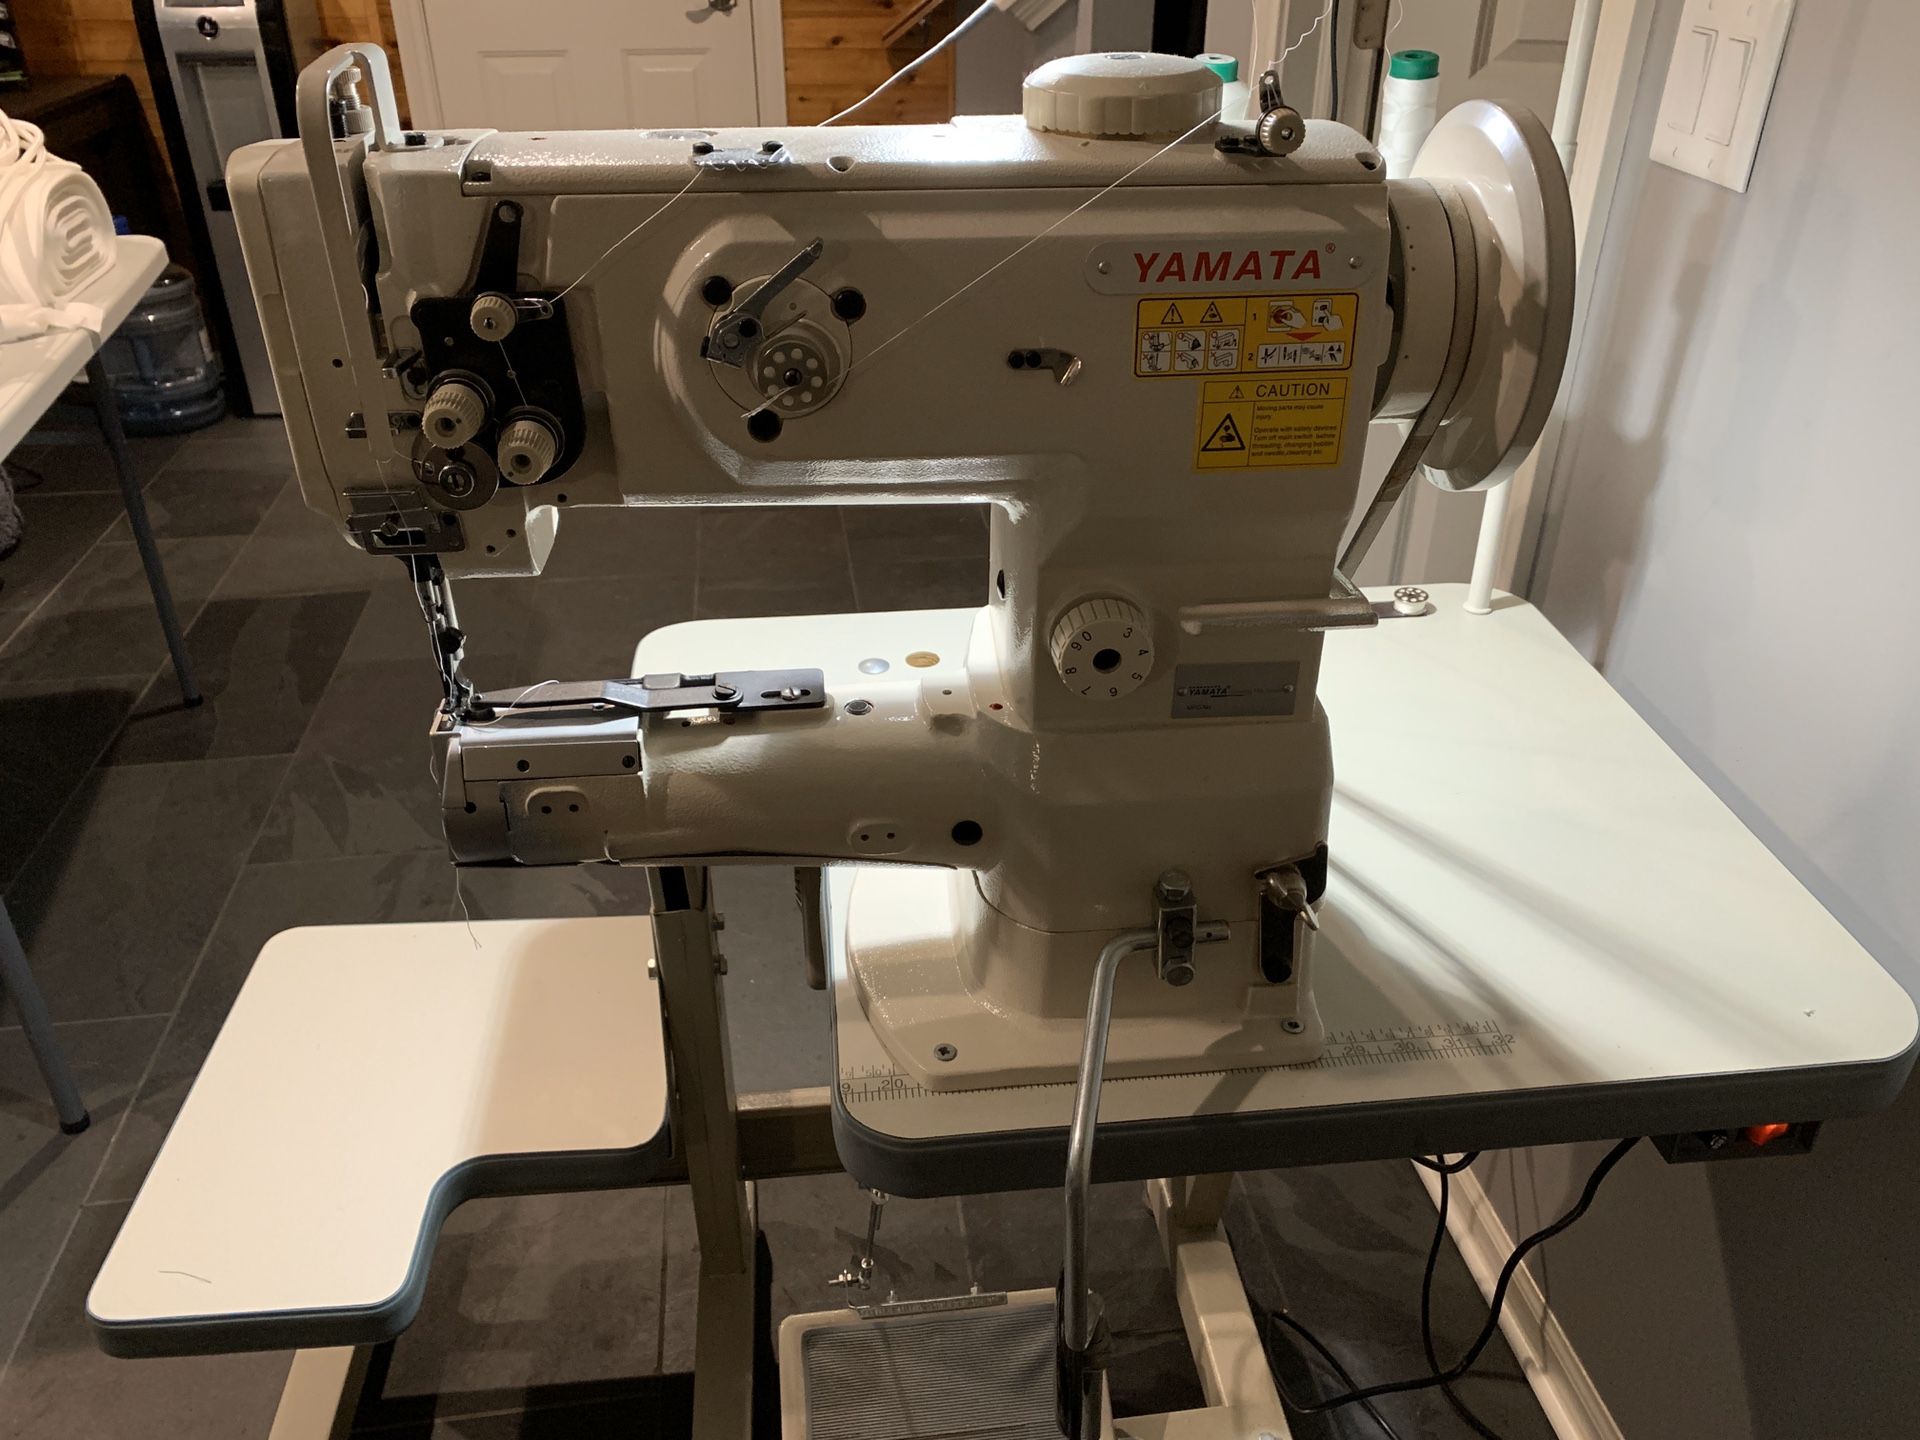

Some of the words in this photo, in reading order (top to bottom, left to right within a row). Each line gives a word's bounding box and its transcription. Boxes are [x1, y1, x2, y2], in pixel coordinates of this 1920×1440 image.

[1133, 249, 1321, 283] YAMATA
[1252, 313, 1257, 321] 1
[1247, 352, 1254, 361] 2
[1255, 382, 1330, 398] CAUTION
[1256, 404, 1278, 412] Moving
[1081, 631, 1092, 642] 0
[1122, 627, 1133, 639] 3
[1065, 666, 1077, 675] 8
[1131, 672, 1143, 681] 5
[1189, 687, 1228, 696] YAMATA
[1343, 1045, 1366, 1056] 29
[1393, 1041, 1416, 1052] 30
[1492, 1034, 1516, 1044] 32
[880, 1078, 904, 1090] 20
